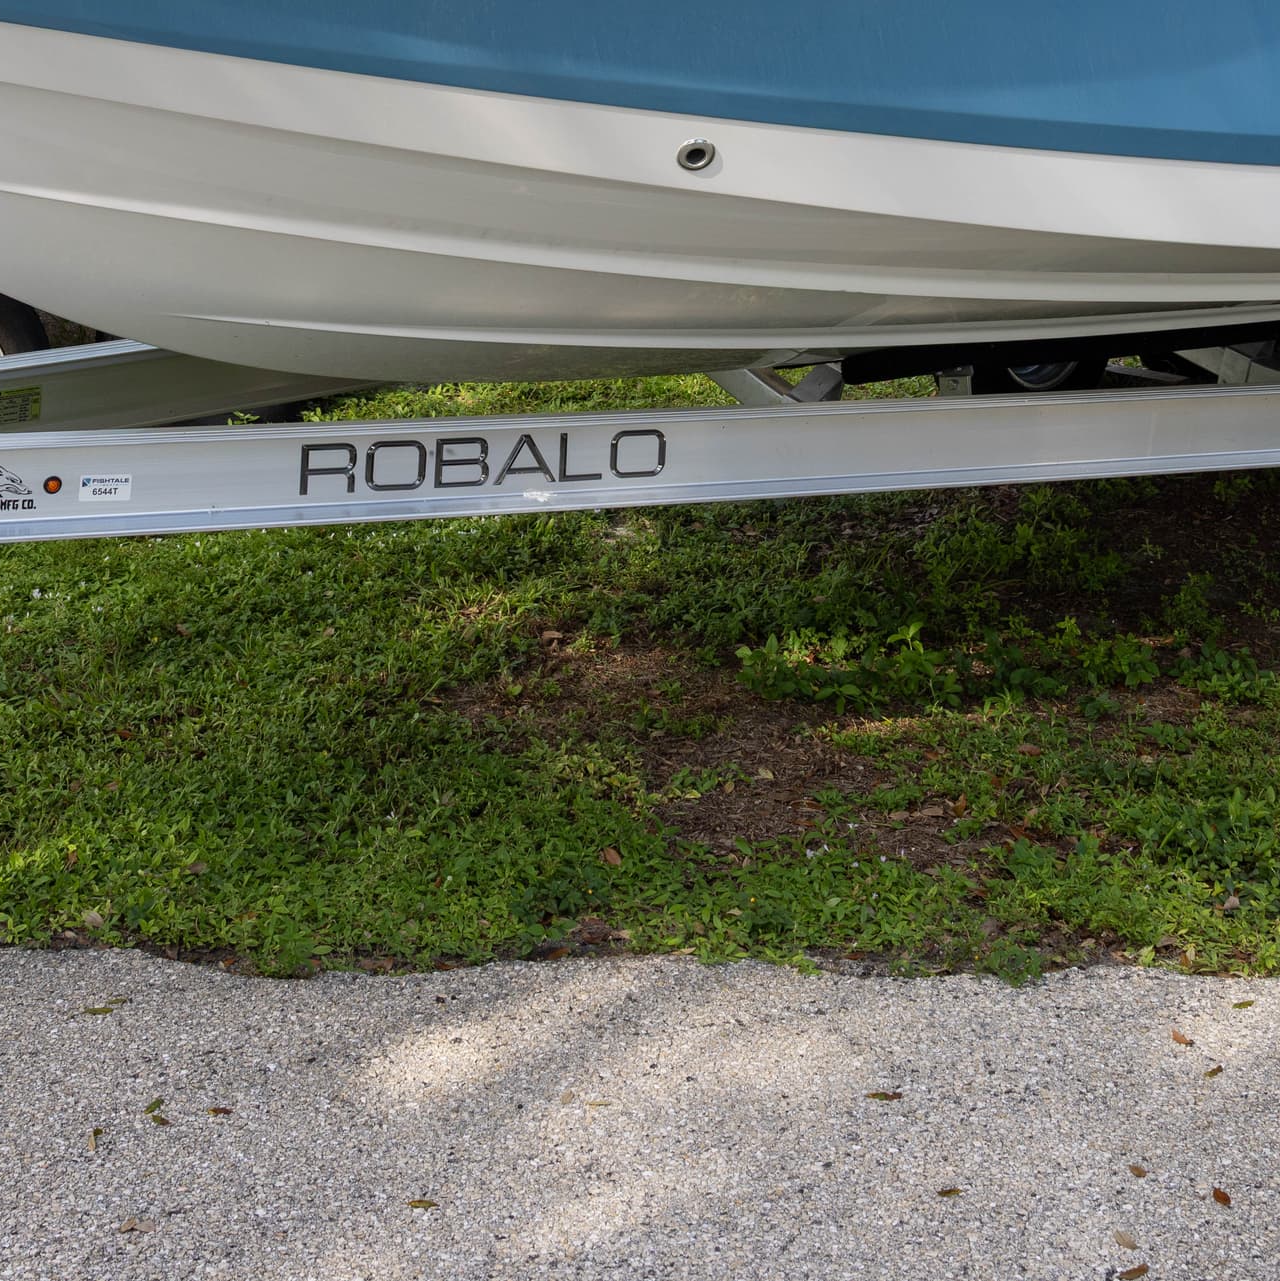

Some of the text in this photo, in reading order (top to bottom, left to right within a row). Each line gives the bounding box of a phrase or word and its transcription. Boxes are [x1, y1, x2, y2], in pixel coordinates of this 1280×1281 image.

[299, 428, 667, 496] ROBALO
[92, 488, 119, 496] 6544T
[0, 498, 19, 511] MFG
[21, 498, 37, 510] CO.
